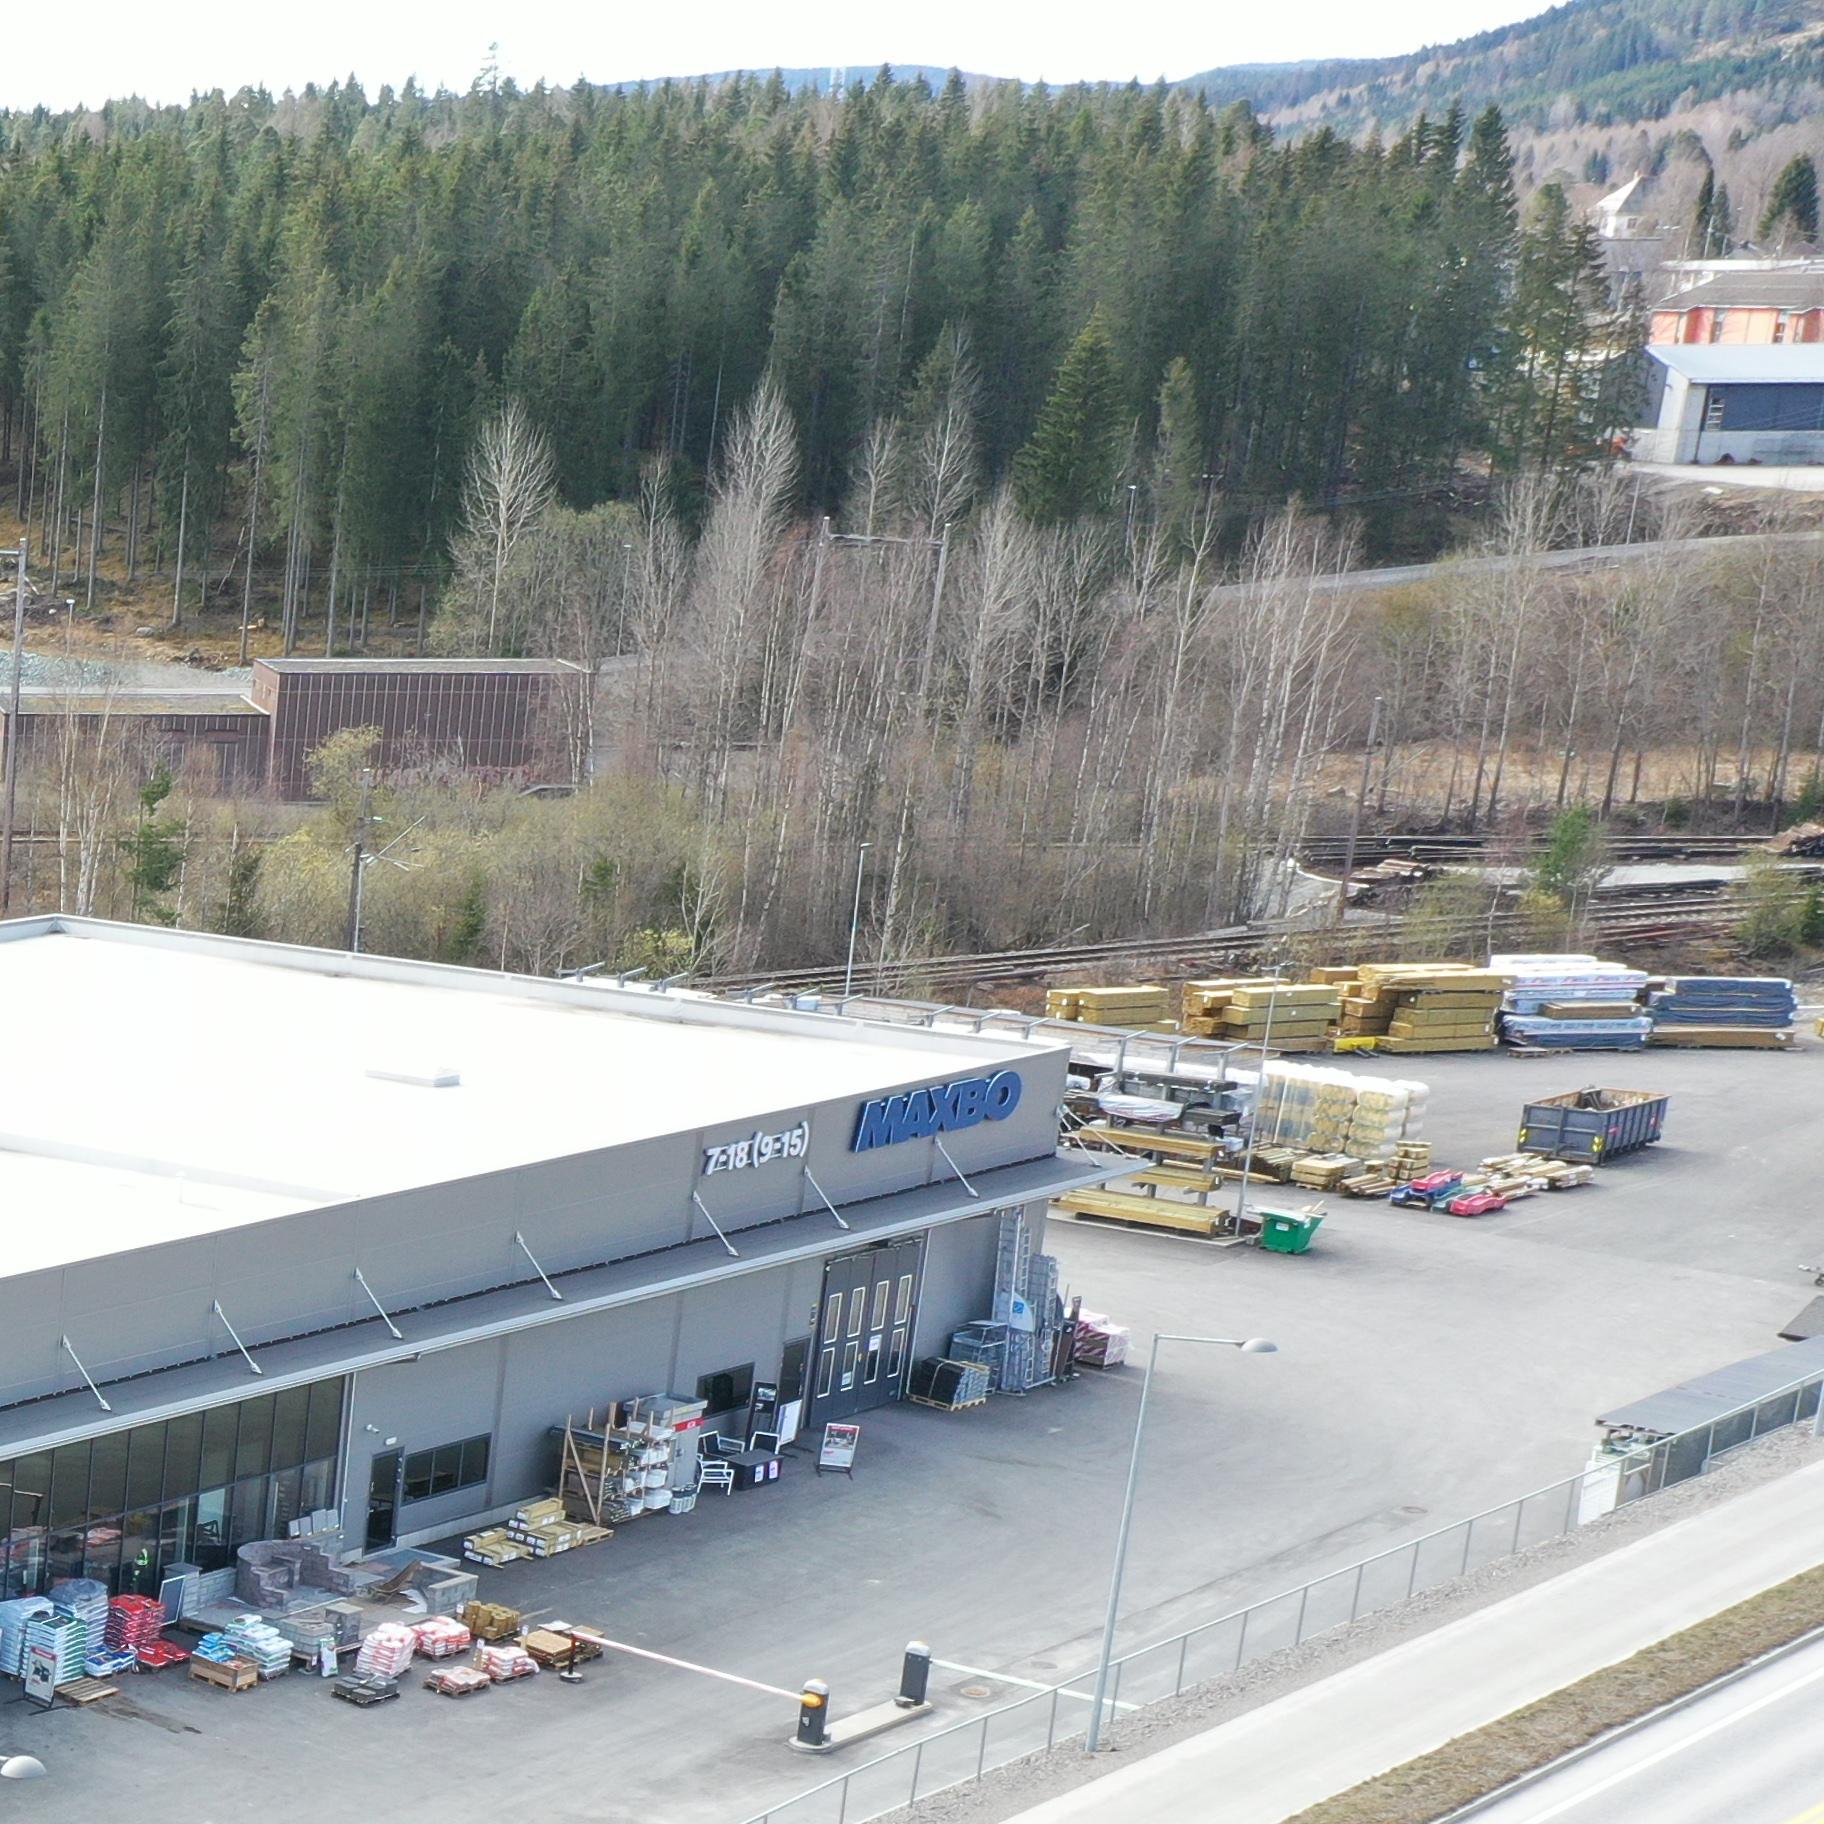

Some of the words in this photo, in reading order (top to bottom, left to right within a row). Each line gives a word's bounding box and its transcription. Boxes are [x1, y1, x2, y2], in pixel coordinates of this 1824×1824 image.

[853, 1069, 1023, 1153] MAXBO
[704, 1140, 751, 1176] 7-18
[752, 1120, 810, 1169] (9-15)
